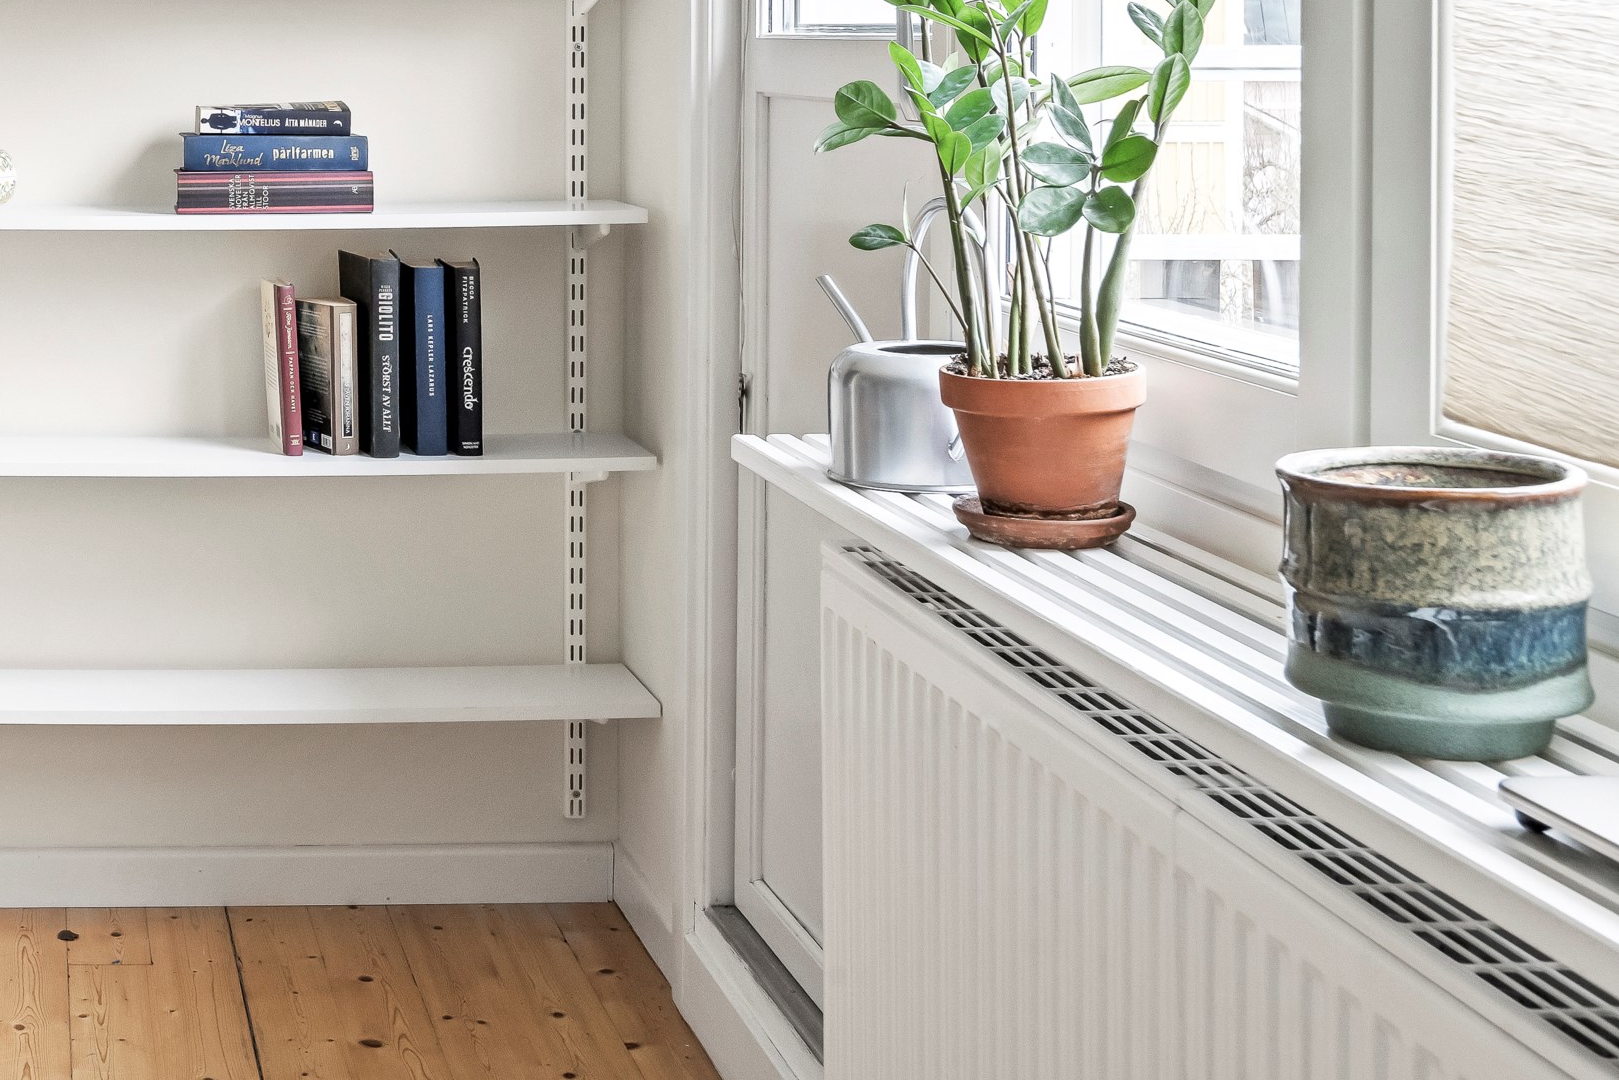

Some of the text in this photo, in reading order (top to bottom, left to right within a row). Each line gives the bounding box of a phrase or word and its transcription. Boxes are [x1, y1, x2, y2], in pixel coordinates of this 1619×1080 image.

[238, 117, 328, 128] MONTELIUS ÅTTA MÅNADER
[220, 139, 245, 154] Liza
[272, 146, 334, 161] pärlfarmen
[204, 152, 264, 167] Marklund
[378, 292, 394, 341] GIOLITO
[382, 354, 393, 433] STÖRST AV ALLT
